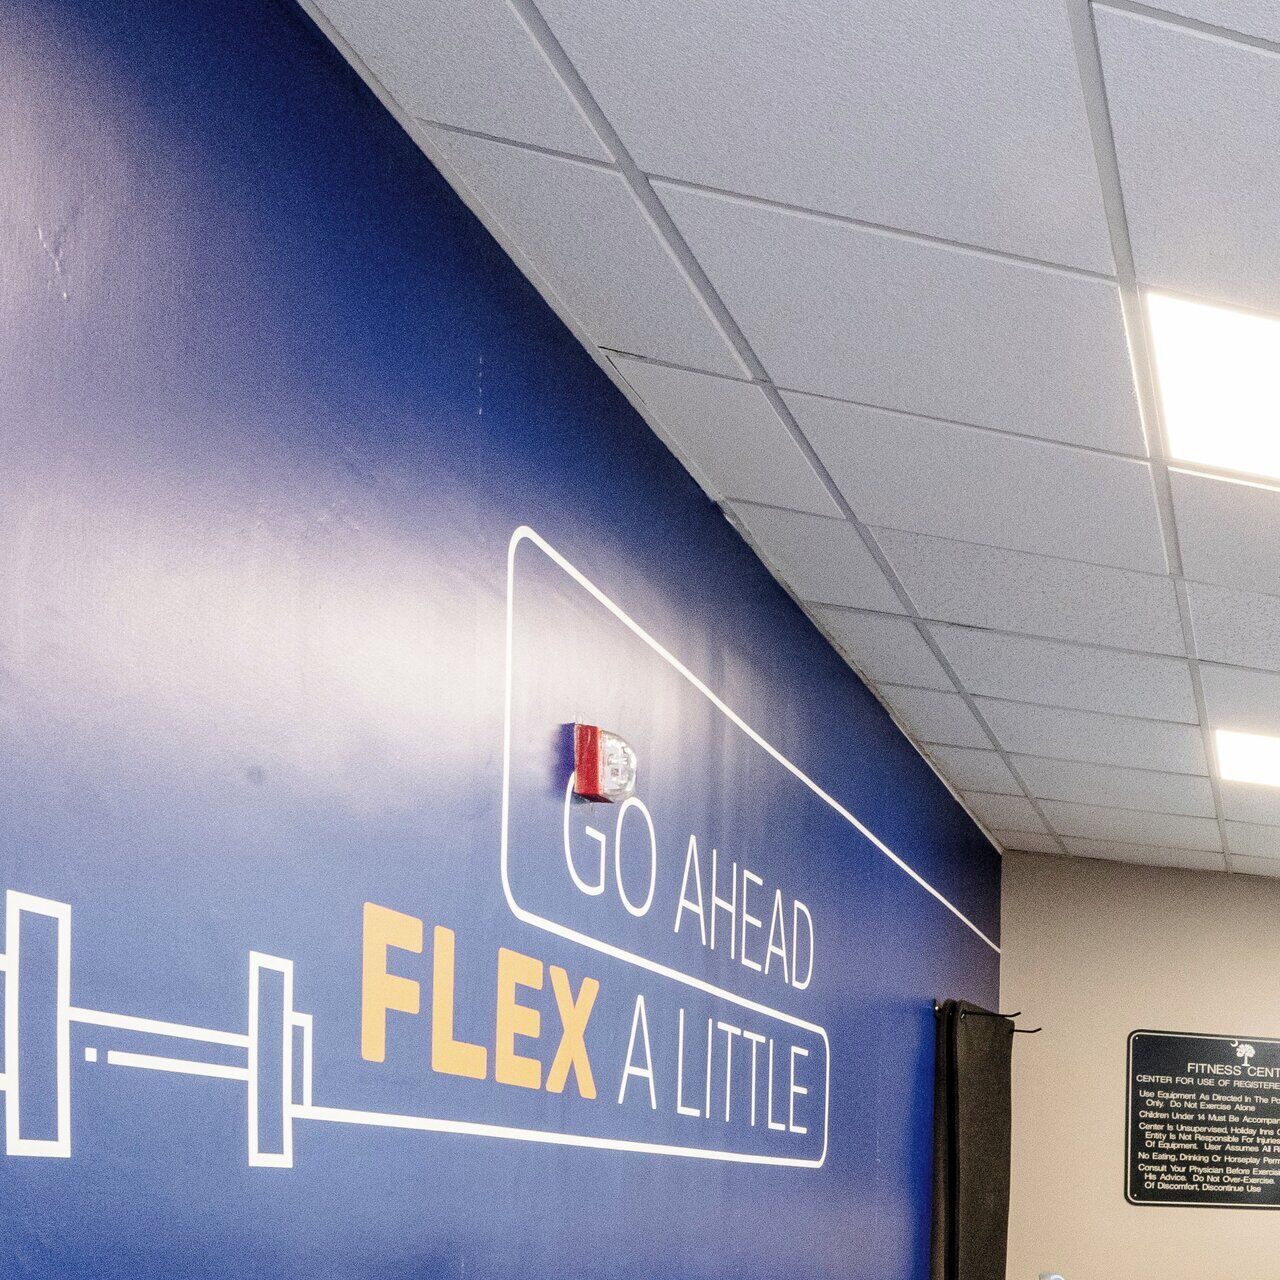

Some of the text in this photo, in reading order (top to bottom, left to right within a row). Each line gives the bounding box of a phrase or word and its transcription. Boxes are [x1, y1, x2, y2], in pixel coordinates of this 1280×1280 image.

[564, 771, 814, 990] GO AHEAD
[360, 901, 808, 1134] FLEX A LITTLE
[1187, 1063, 1241, 1075] FITNESS
[1136, 1075, 1172, 1083] CENTER
[1176, 1076, 1194, 1084] FOR
[1197, 1078, 1214, 1086] USE
[1140, 1090, 1154, 1098] Use
[1158, 1091, 1196, 1100] Equipment
[1212, 1094, 1242, 1102] Directed
[1170, 1100, 1181, 1108] Do
[1200, 1102, 1231, 1110] Exercise
[1234, 1104, 1256, 1112] Alone
[1139, 1110, 1169, 1118] Children
[1172, 1112, 1194, 1120] Under
[1139, 1122, 1164, 1130] Center
[1231, 1126, 1256, 1136] Holiday
[1146, 1132, 1166, 1140] Entity
[1170, 1132, 1176, 1140] Is
[1195, 1134, 1238, 1142] Responsible
[1257, 1136, 1280, 1145] Injuries
[1146, 1140, 1155, 1148] Of
[1225, 1144, 1259, 1152] Assumes
[1152, 1152, 1178, 1162] Eating,
[1180, 1154, 1209, 1162] Drinking
[1224, 1156, 1260, 1164] Horseplay
[1138, 1164, 1166, 1172] Consult
[1189, 1166, 1223, 1174] Physician
[1144, 1172, 1156, 1180] His
[1158, 1182, 1200, 1190] Discomfort,
[1202, 1184, 1244, 1192] Discontinue
